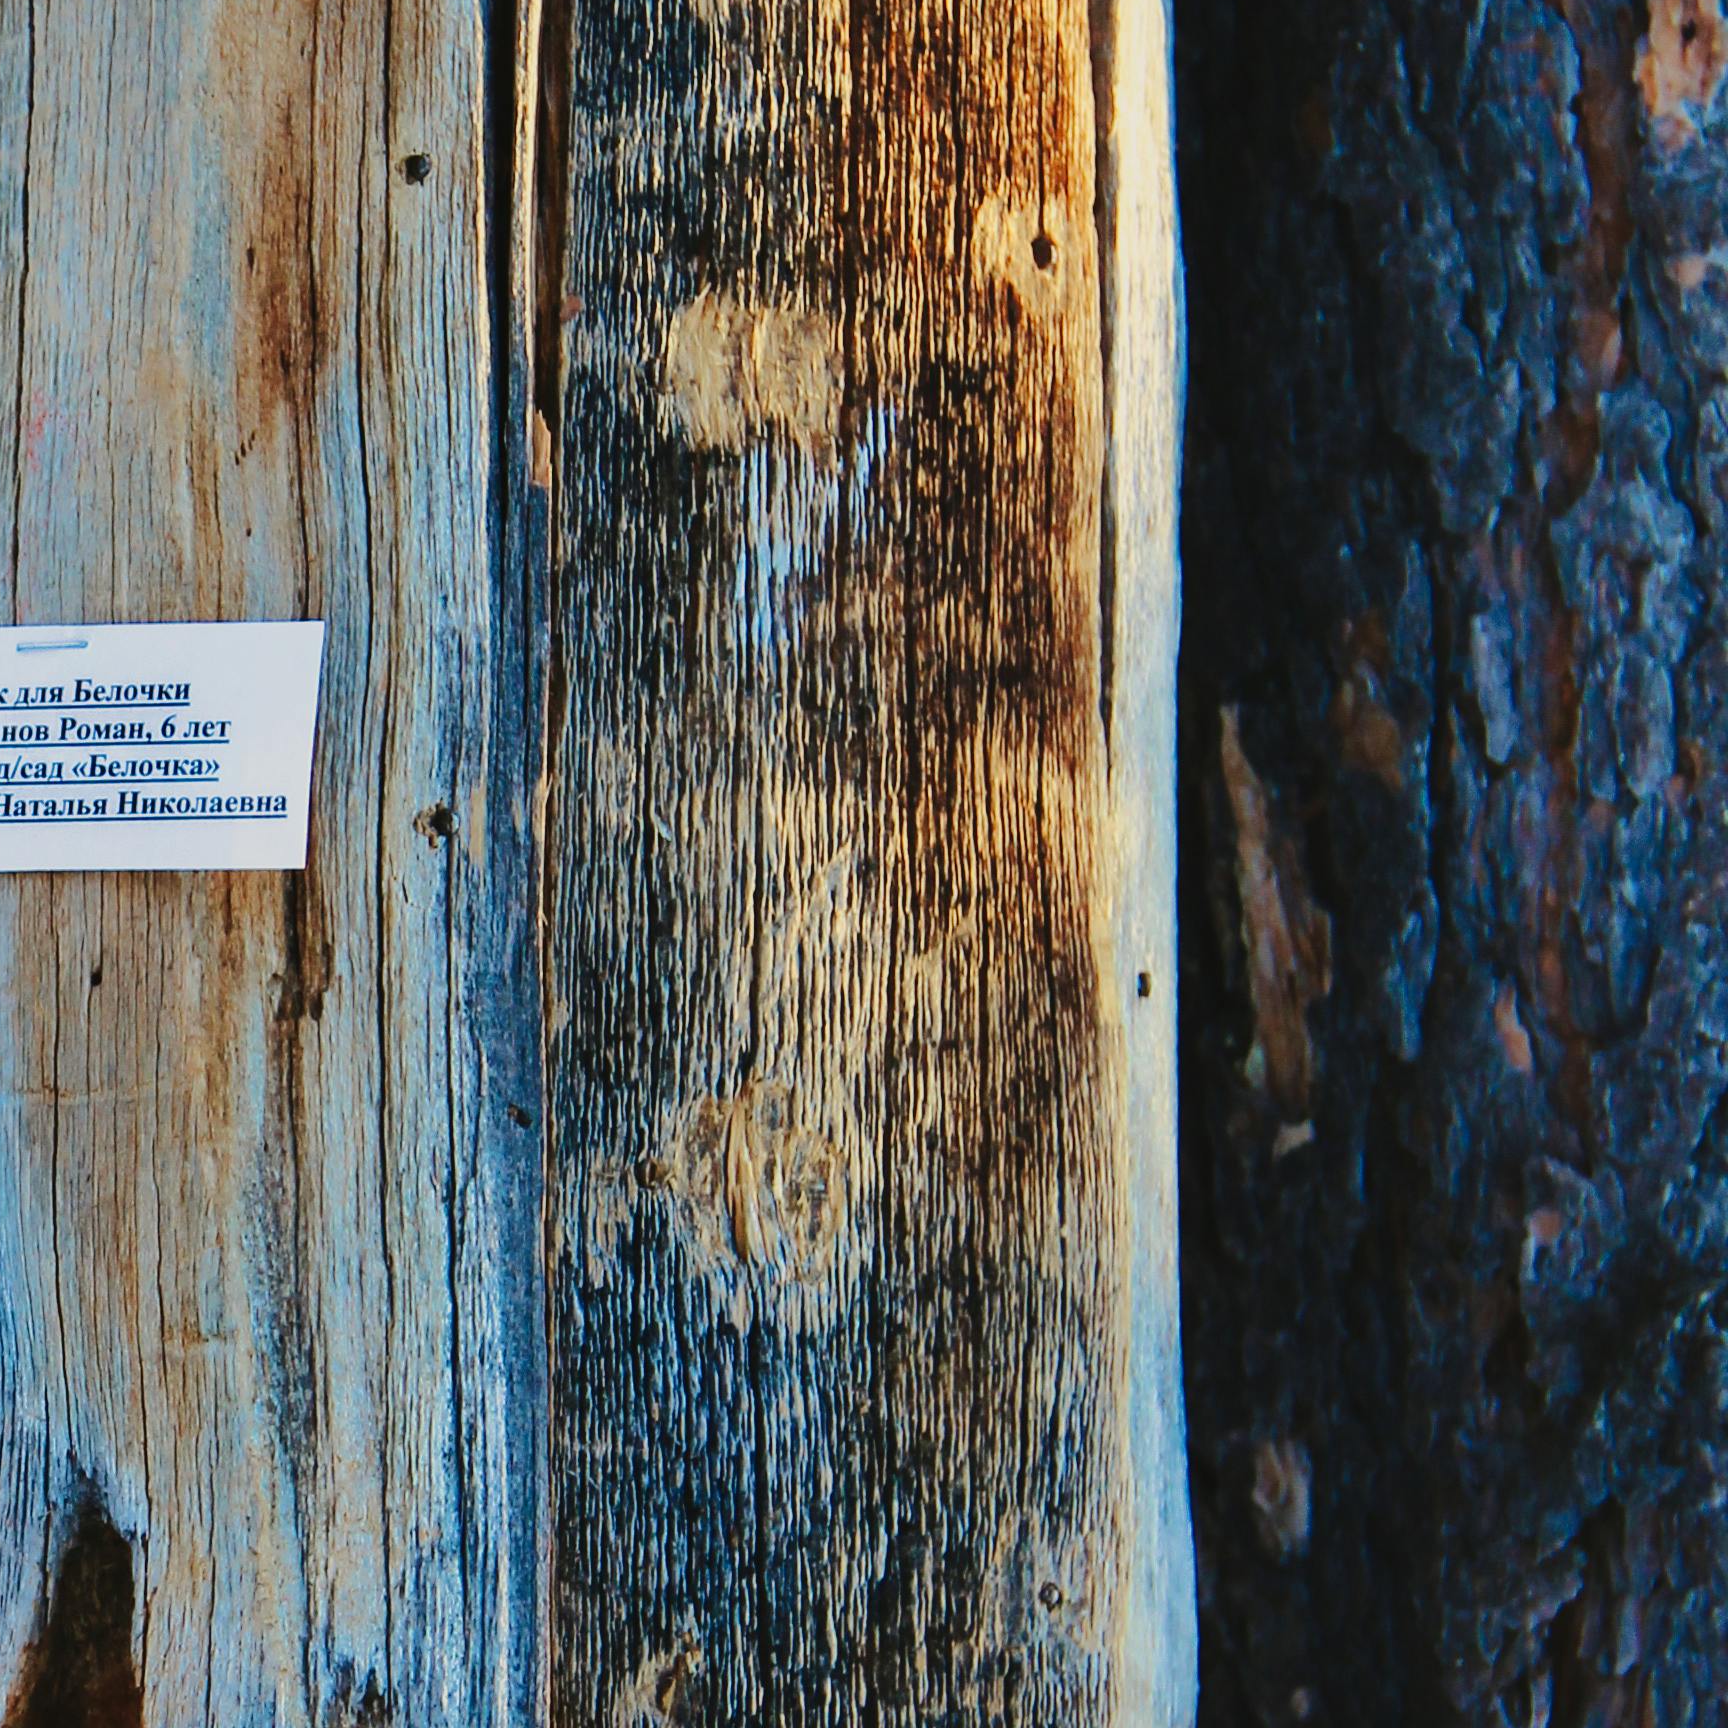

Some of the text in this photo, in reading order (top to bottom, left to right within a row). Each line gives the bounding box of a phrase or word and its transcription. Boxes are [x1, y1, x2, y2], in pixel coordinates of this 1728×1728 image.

[14, 684, 63, 709] для
[72, 679, 191, 703] Белочки
[59, 718, 153, 744] Роман,
[160, 715, 176, 739] 6
[183, 719, 231, 739] лет
[72, 755, 220, 778] «Белочка»
[118, 791, 287, 815] Николаевна
